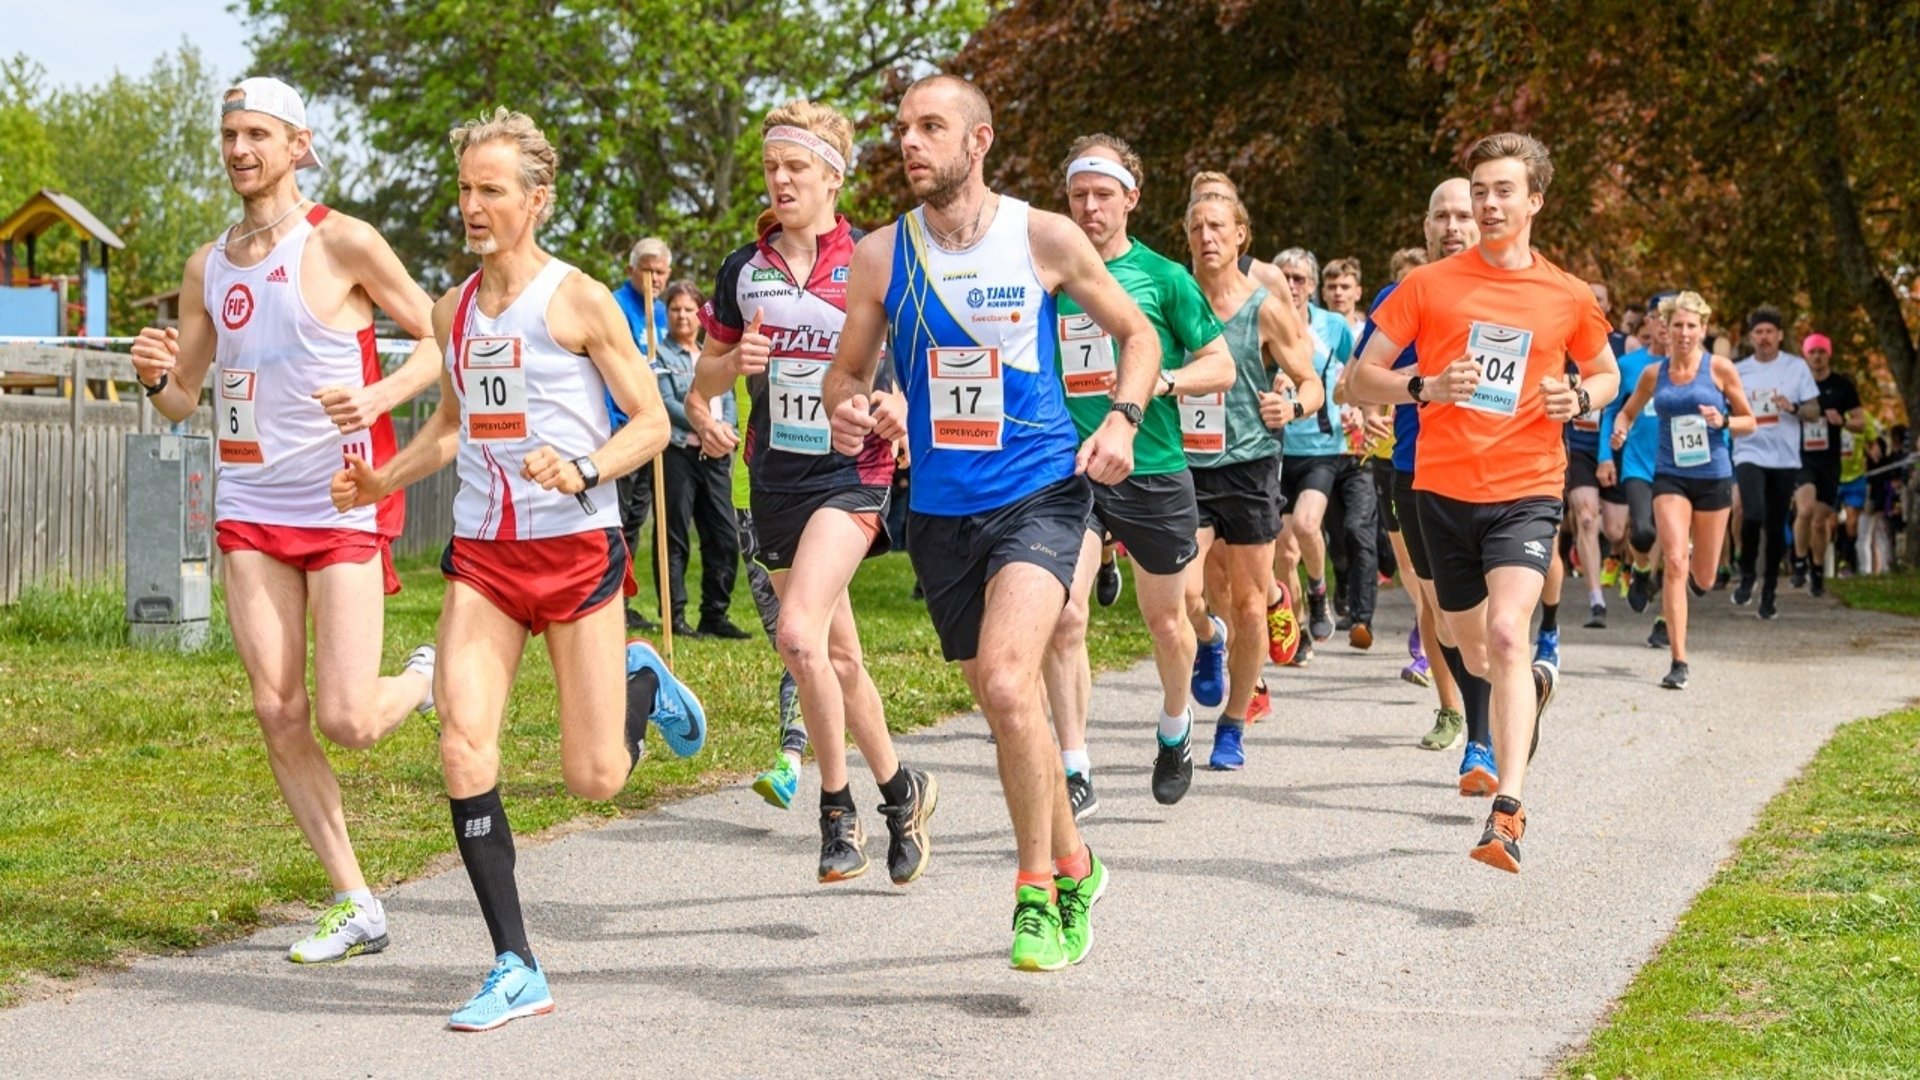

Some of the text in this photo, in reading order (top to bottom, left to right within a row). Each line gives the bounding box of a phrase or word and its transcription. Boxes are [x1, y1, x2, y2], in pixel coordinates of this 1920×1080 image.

[986, 286, 1026, 300] TJALVE
[227, 298, 246, 316] FIF
[971, 313, 1009, 323] Swedbank
[1080, 344, 1092, 368] 7
[1475, 354, 1516, 385] 104
[479, 375, 507, 407] 10
[1068, 378, 1101, 389] OPPEBYLÖ
[779, 392, 822, 422] 117
[949, 385, 982, 415] 17
[1762, 402, 1770, 413] 4
[230, 405, 239, 435] 6
[472, 421, 521, 431] OPPEBYLÖPET
[1195, 409, 1206, 429] 2
[775, 431, 824, 444] OPPEBYLÖPET
[940, 427, 995, 442] OPPEBYLÖPET
[1679, 433, 1704, 449] 134
